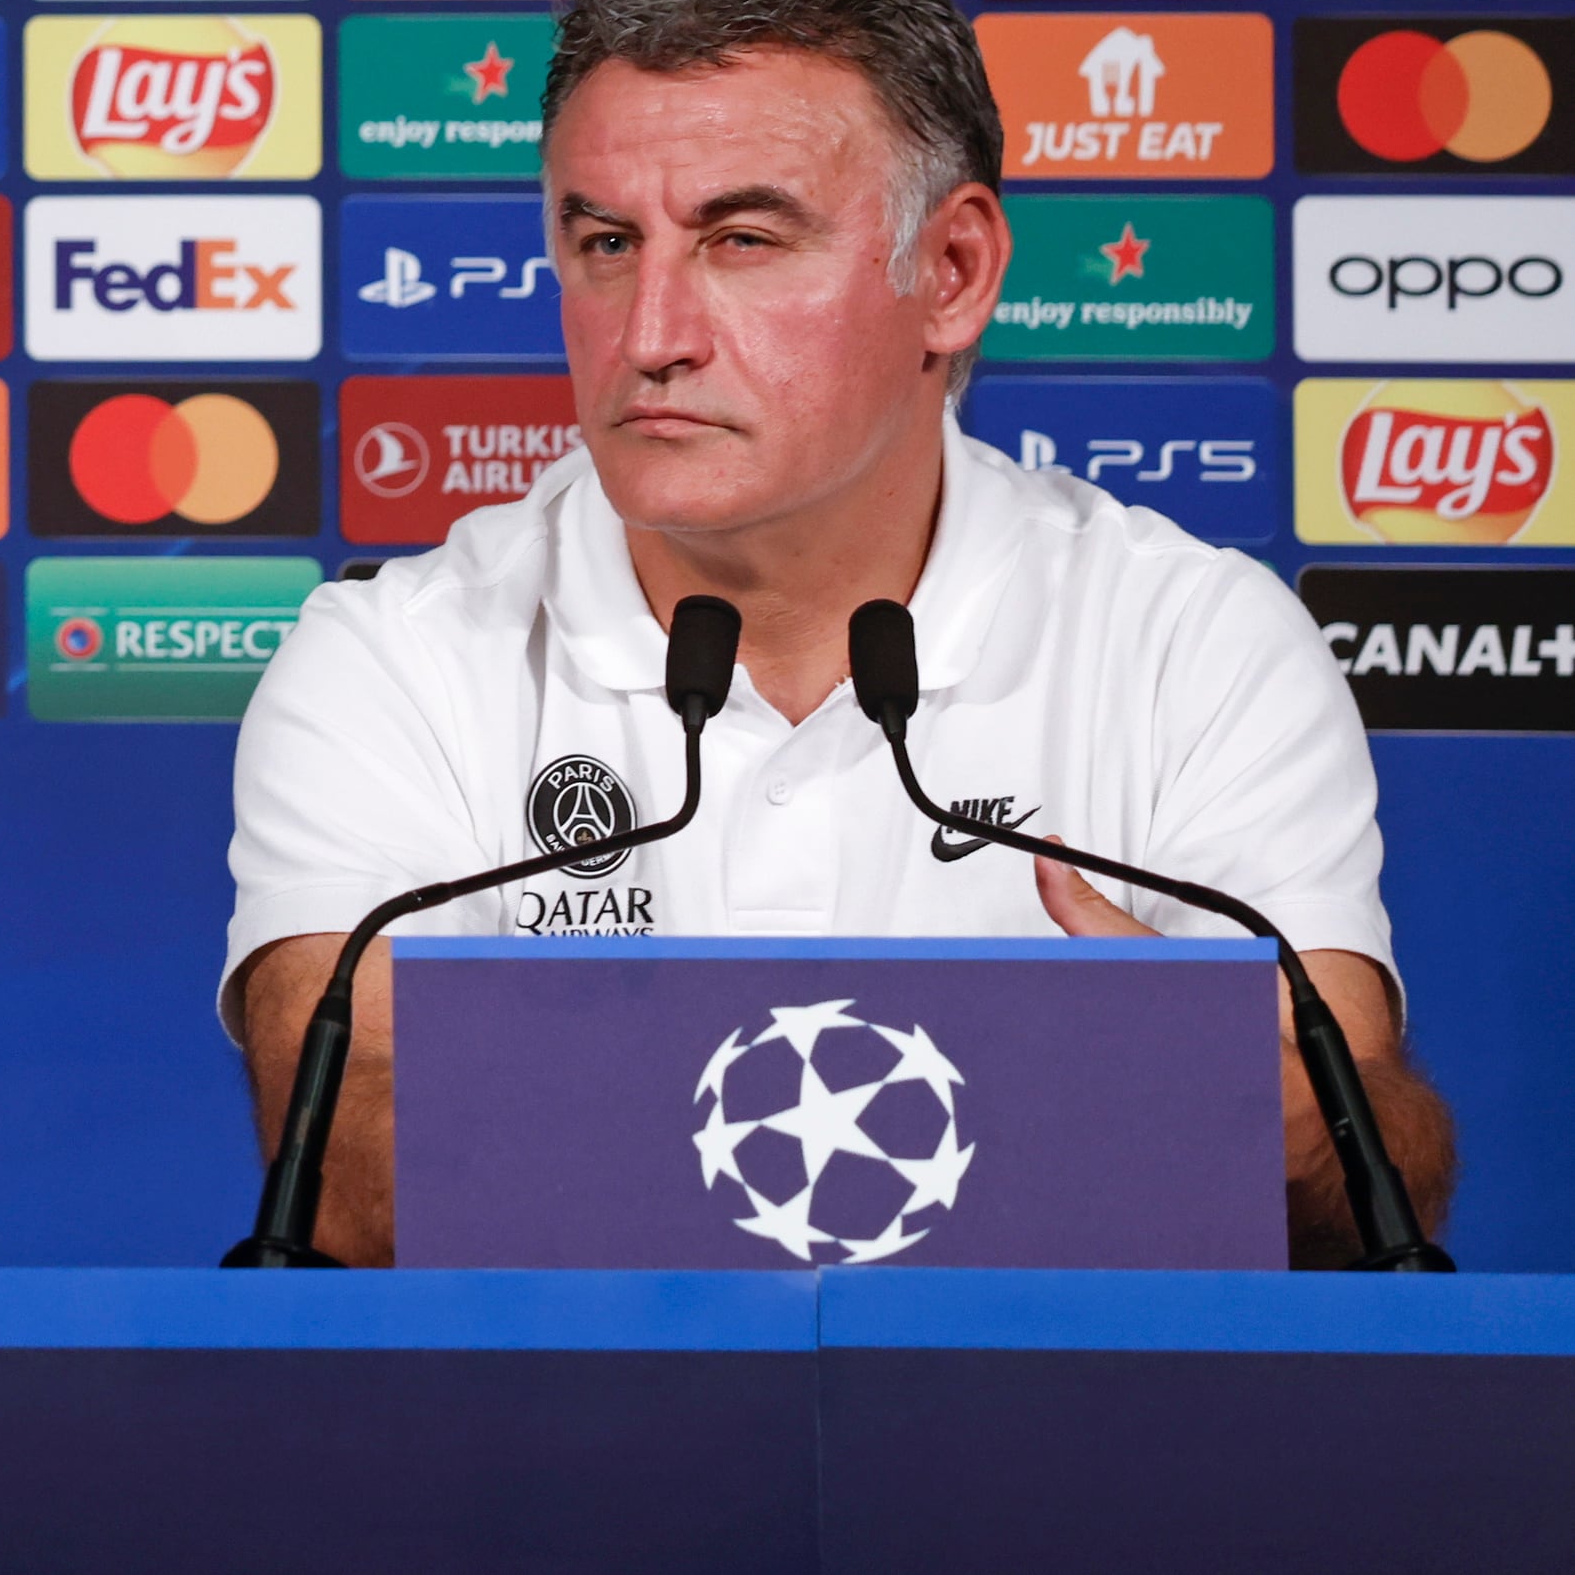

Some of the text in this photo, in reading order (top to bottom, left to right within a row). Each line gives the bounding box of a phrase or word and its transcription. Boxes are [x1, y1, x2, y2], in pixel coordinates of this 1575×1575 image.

[83, 46, 264, 155] Lay's
[359, 116, 543, 148] enjoy respon
[1022, 122, 1222, 165] JUST EAT
[54, 240, 297, 311] FedEx
[450, 257, 550, 298] PS
[1329, 256, 1563, 310] oppo
[995, 296, 1252, 329] enjoy responsibly
[443, 425, 583, 458] TURKIS
[1088, 440, 1255, 481] PS5
[1355, 412, 1542, 519] Lay's
[1320, 622, 1575, 675] CANAL+
[548, 763, 615, 793] PARIS
[516, 887, 654, 936] QATAR
